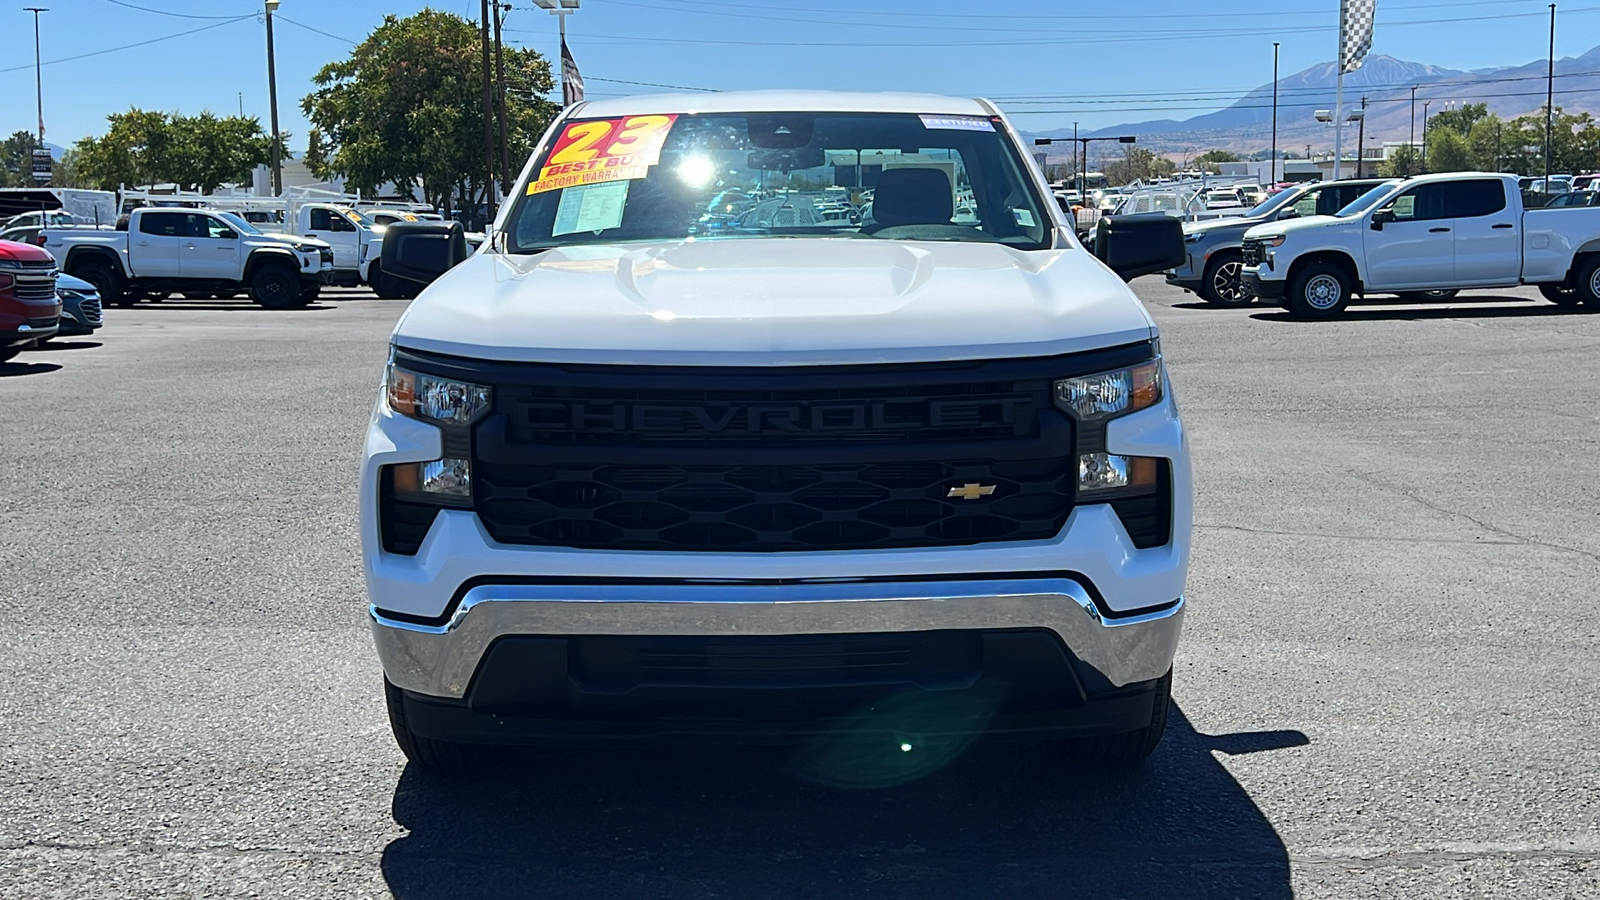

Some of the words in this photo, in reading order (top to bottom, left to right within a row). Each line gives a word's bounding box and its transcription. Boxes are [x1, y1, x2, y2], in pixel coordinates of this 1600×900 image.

[925, 118, 989, 128] CERTIFIED
[550, 115, 671, 165] 23
[545, 159, 602, 177] BEST
[533, 174, 581, 192] FACTORY
[516, 396, 1033, 432] CHEVROLET
